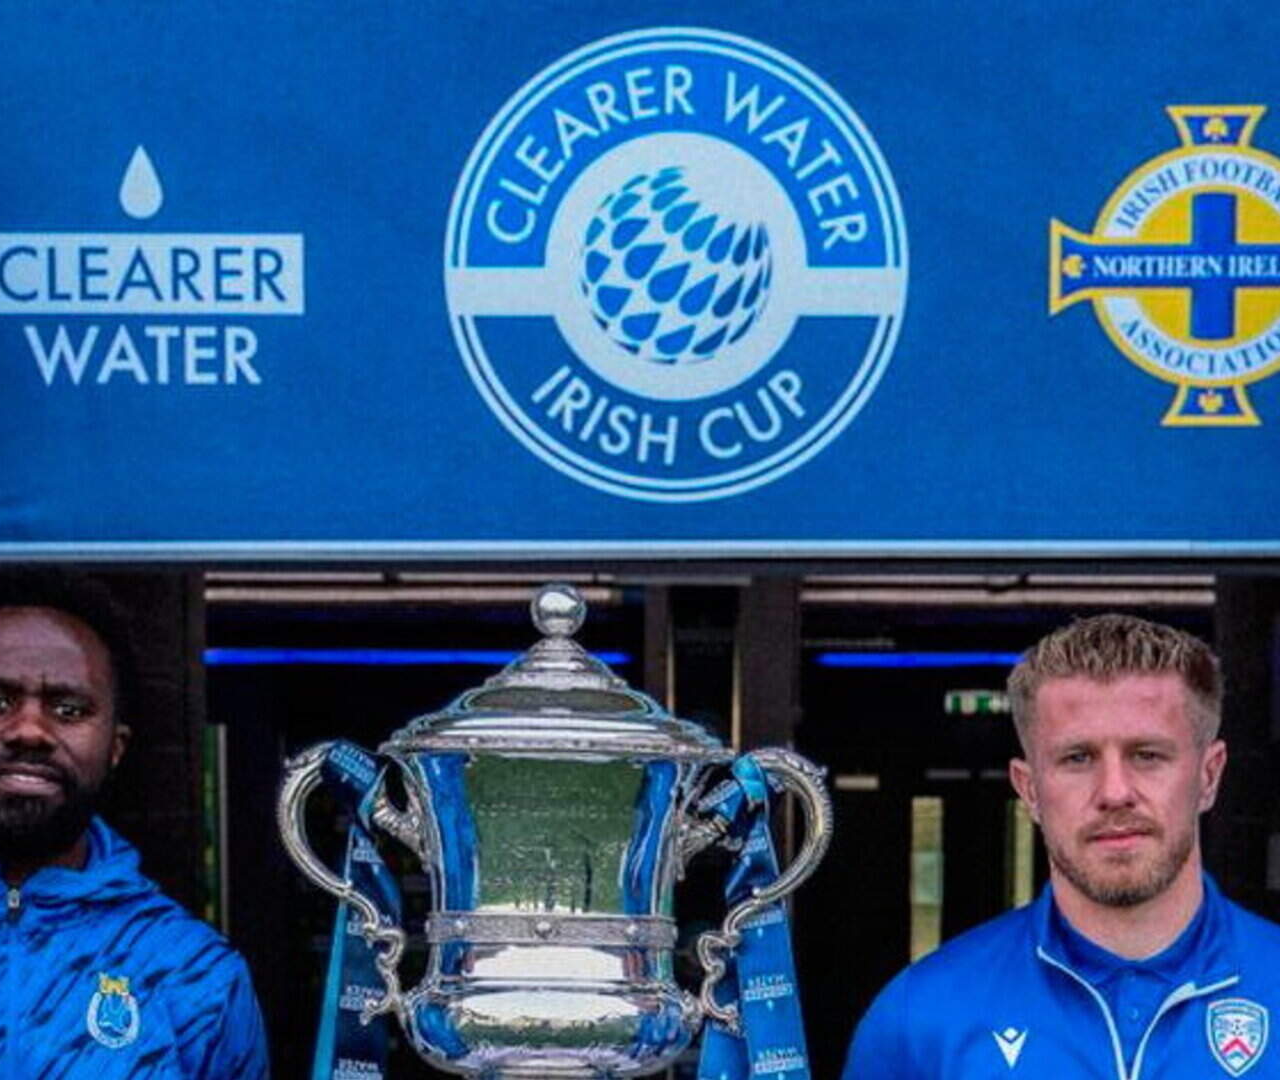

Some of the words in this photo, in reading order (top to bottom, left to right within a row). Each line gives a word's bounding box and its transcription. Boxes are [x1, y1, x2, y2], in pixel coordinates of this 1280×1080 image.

[486, 65, 694, 243] CLEARER
[724, 71, 869, 250] WATER
[1117, 163, 1181, 230] IRISH
[1093, 253, 1221, 278] NORTHERN
[24, 324, 262, 386] WATER
[531, 365, 679, 465] IRISH
[699, 369, 807, 460] CUP
